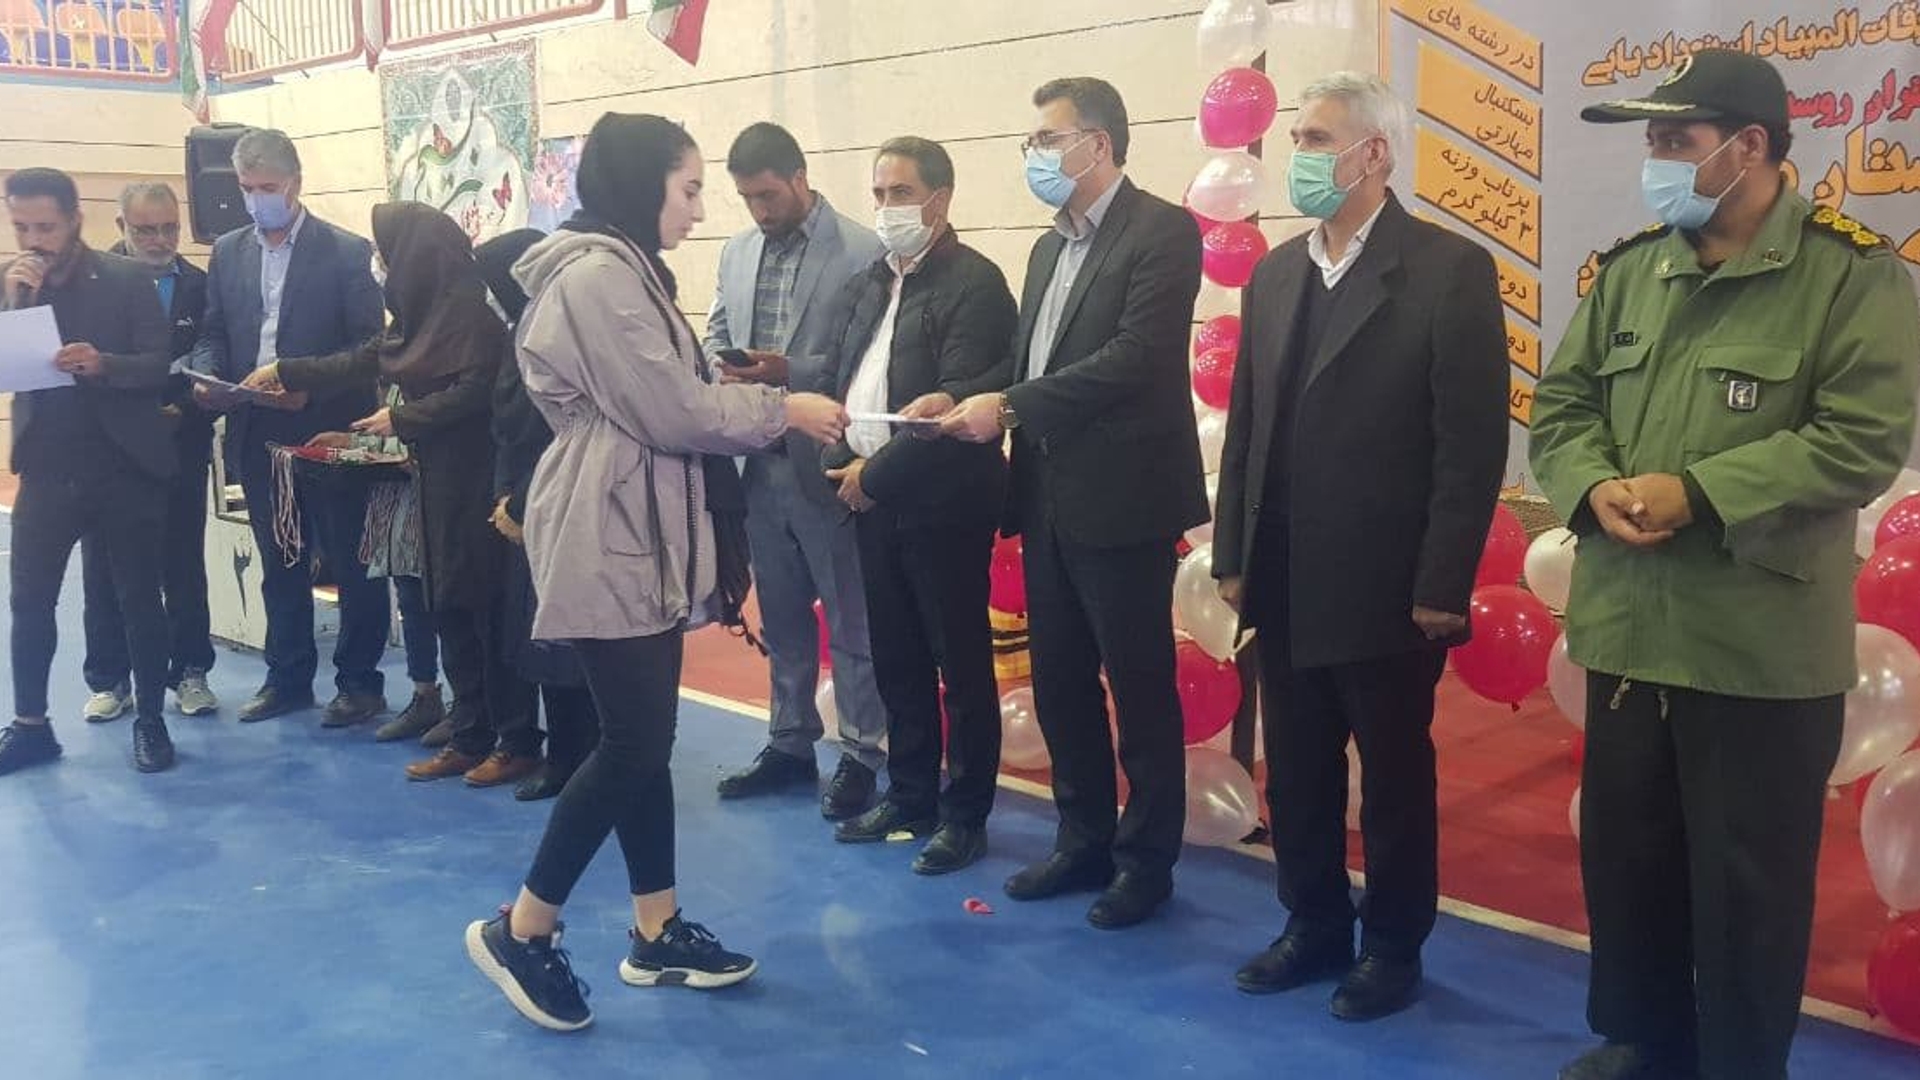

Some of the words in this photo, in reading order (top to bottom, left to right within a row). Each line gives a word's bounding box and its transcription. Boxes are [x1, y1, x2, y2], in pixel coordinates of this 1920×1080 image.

[1427, 6, 1461, 31] های
[1756, 7, 1859, 60] المپیاد
[1467, 24, 1510, 57] رشته
[1509, 53, 1534, 70] در
[1474, 83, 1534, 131] بسکتبال
[1476, 125, 1533, 159] مهارتی
[1441, 148, 1478, 181] وزنه
[1482, 177, 1530, 216] پرتاب
